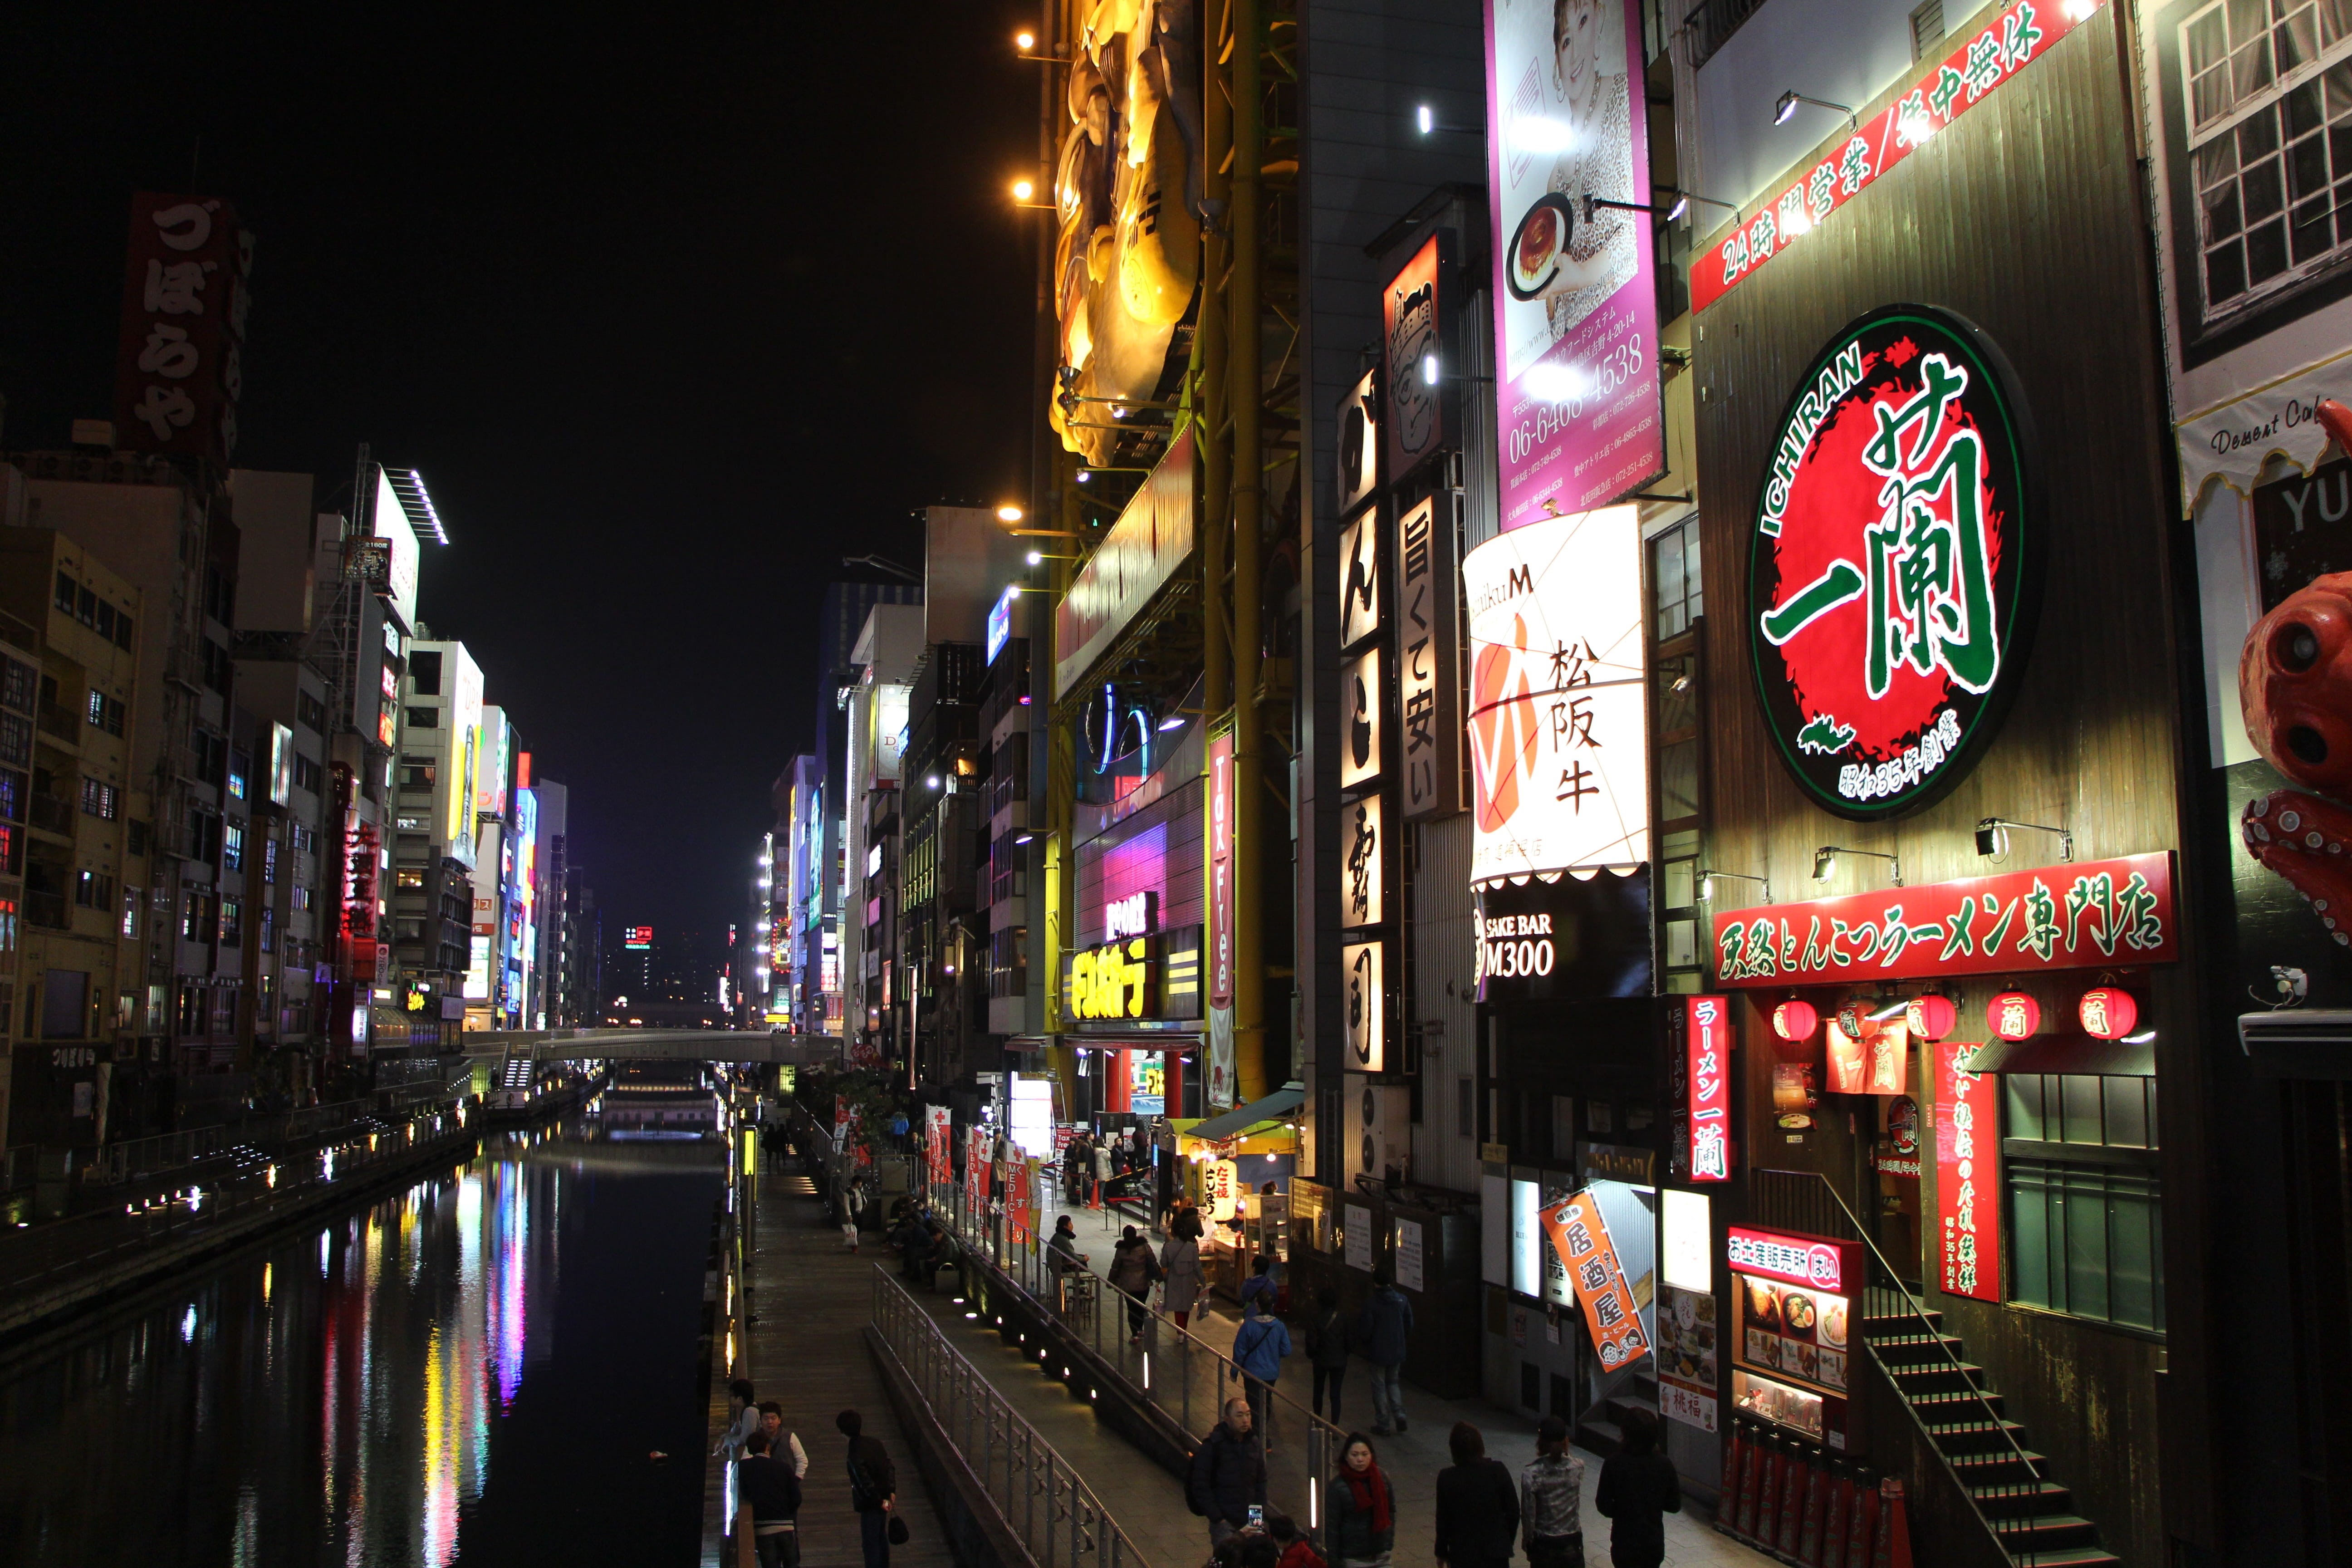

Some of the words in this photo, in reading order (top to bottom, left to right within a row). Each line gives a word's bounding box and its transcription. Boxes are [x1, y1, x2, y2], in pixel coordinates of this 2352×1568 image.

[134, 200, 220, 441] づぼらや
[1607, 310, 1635, 342] 4-20-14
[1760, 341, 1862, 538] ICHIRAN
[2211, 412, 2279, 454] Dessert
[1761, 353, 1998, 700] 一蘭
[1405, 510, 1434, 806] 旨くて安い
[1548, 635, 1602, 816] 松阪牛
[1838, 708, 1961, 801] 昭和35年創業
[1214, 755, 1225, 852] Tax
[1216, 865, 1226, 992] Free
[1486, 916, 1516, 938] SAKE
[1517, 914, 1552, 936] BAR
[1719, 871, 2163, 980] 天然とんこつラーメン専門店
[1485, 939, 1554, 977] M300
[1838, 1001, 1860, 1037] 一蘭
[1906, 1000, 1929, 1036] 一蘭
[2000, 995, 2027, 1037] 一蘭
[2083, 991, 2107, 1037] 一蘭
[1216, 1166, 1230, 1198] たこ焼
[1555, 1207, 1579, 1223] 味自慢
[1728, 1235, 1807, 1278] お土産販売所
[1945, 1216, 1955, 1289] 昭和35年創業
[1565, 1222, 1625, 1328] 居酒屋
[1602, 1322, 1629, 1339] 酒・ビール
[1673, 1387, 1701, 1420] 桃福
